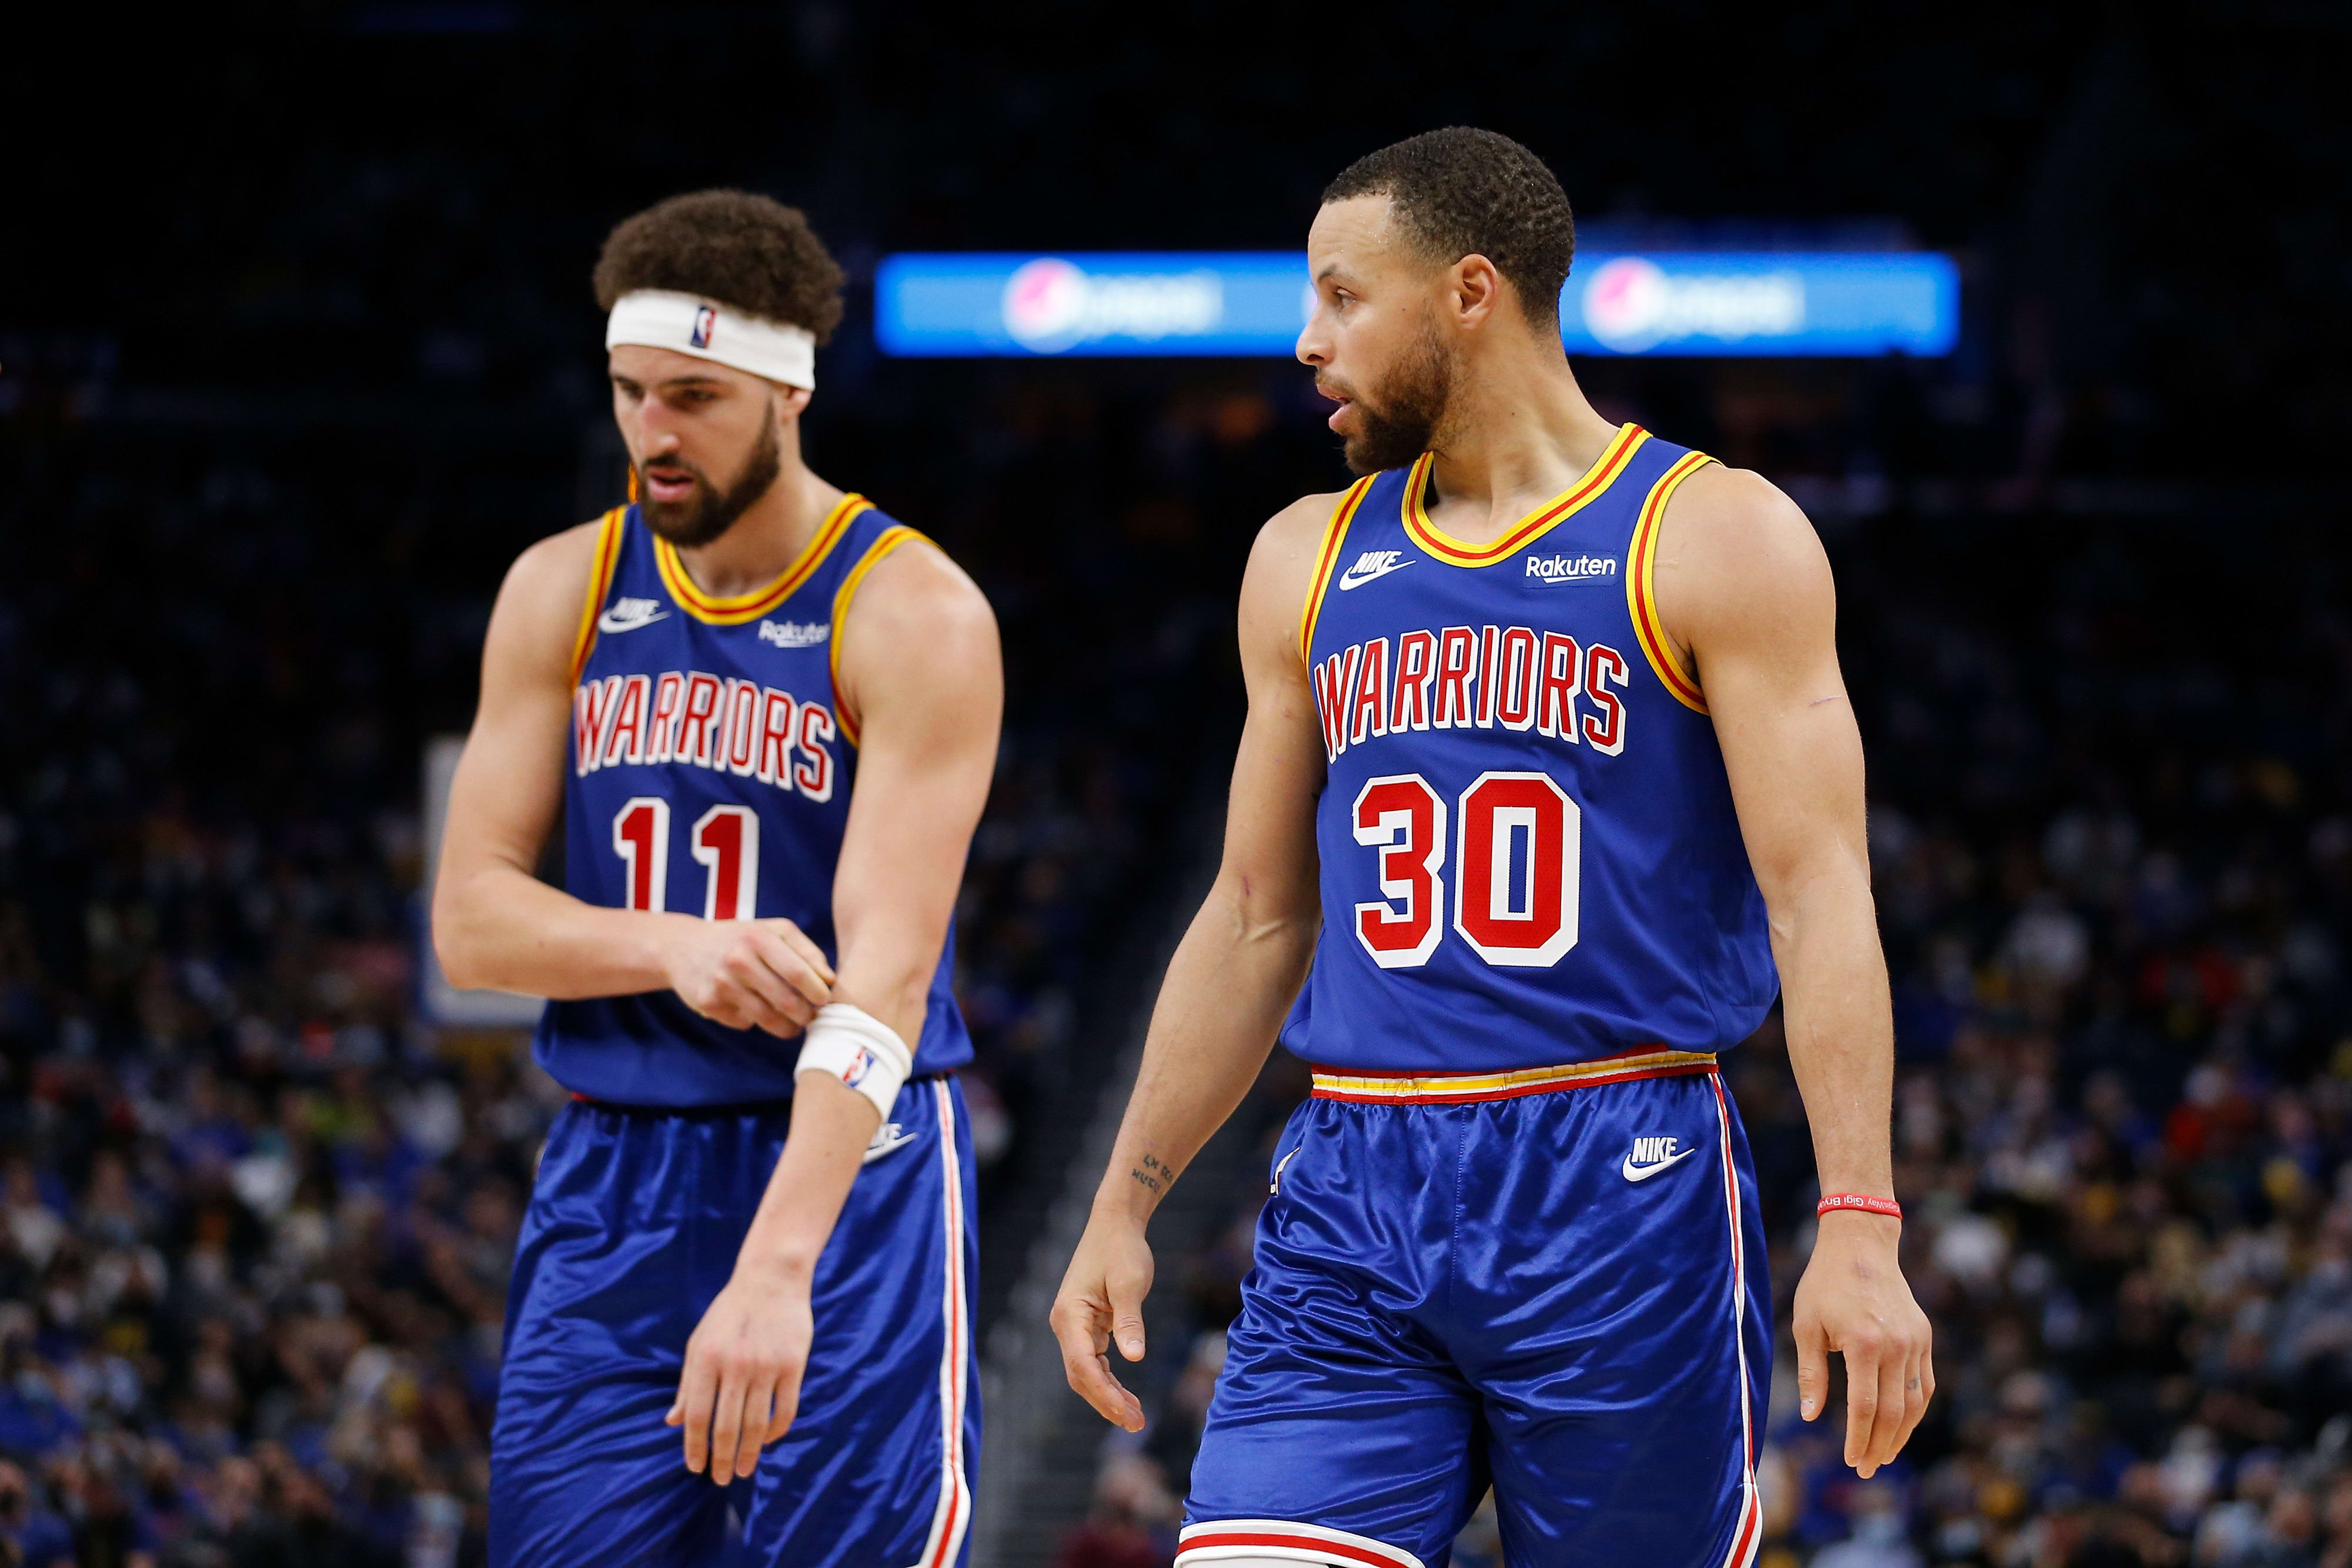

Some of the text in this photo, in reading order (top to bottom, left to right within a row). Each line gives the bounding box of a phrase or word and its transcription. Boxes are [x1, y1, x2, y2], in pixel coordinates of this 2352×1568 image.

[1350, 550, 1402, 574] NIKE
[1525, 554, 1616, 577] Rakuten
[1314, 625, 1629, 764] WARRIORS
[574, 670, 836, 803] WARRIORS
[612, 796, 760, 921] 11
[1352, 770, 1581, 969] 30
[1631, 1136, 1678, 1162] NIKE
[1843, 1195, 1864, 1207] Gigi
